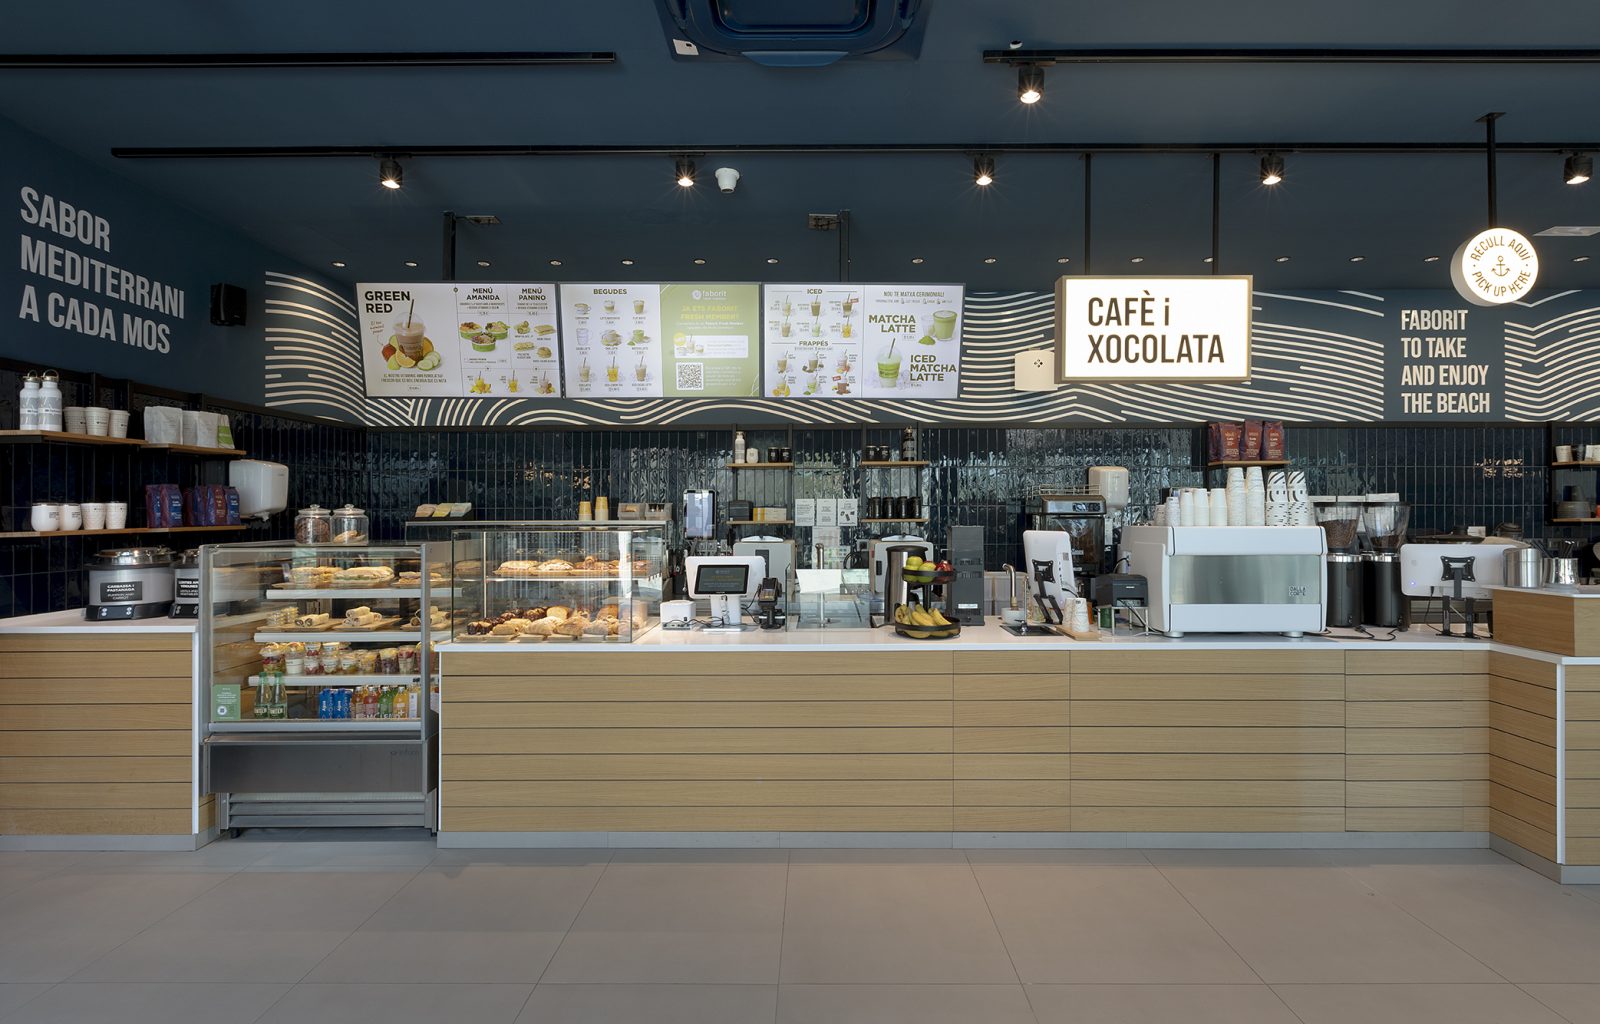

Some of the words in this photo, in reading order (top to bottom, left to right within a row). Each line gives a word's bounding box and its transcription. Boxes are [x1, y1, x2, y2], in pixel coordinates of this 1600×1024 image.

[20, 186, 110, 253] SABOR
[1470, 235, 1505, 261] RECULL
[20, 234, 185, 319] MEDITERRANI
[1472, 271, 1492, 293] PICK
[1493, 286, 1507, 297] UP
[1508, 270, 1531, 294] HERE
[365, 291, 411, 301] GREEN
[472, 286, 493, 294] MENÚ
[521, 286, 542, 294] MENÚ
[702, 289, 727, 297] faborit
[366, 303, 393, 313] RED
[1088, 289, 1155, 326] CAFÈ
[1164, 297, 1170, 326] i
[19, 284, 40, 323] A
[48, 292, 117, 342] CADA
[123, 313, 171, 354] MOS
[868, 314, 916, 323] MATCHA
[881, 324, 916, 333] LATTE
[1401, 309, 1468, 330] FABORIT
[1087, 334, 1224, 363] XOCOLATA
[1400, 337, 1422, 358] TO
[1425, 337, 1467, 358] TAKE
[910, 355, 936, 363] ICED
[910, 364, 957, 372] MATCHA
[910, 373, 944, 381] LATTE
[1401, 365, 1435, 386] AND
[1439, 364, 1489, 386] ENJOY
[1401, 392, 1433, 414] THE
[1437, 392, 1490, 414] BEACH
